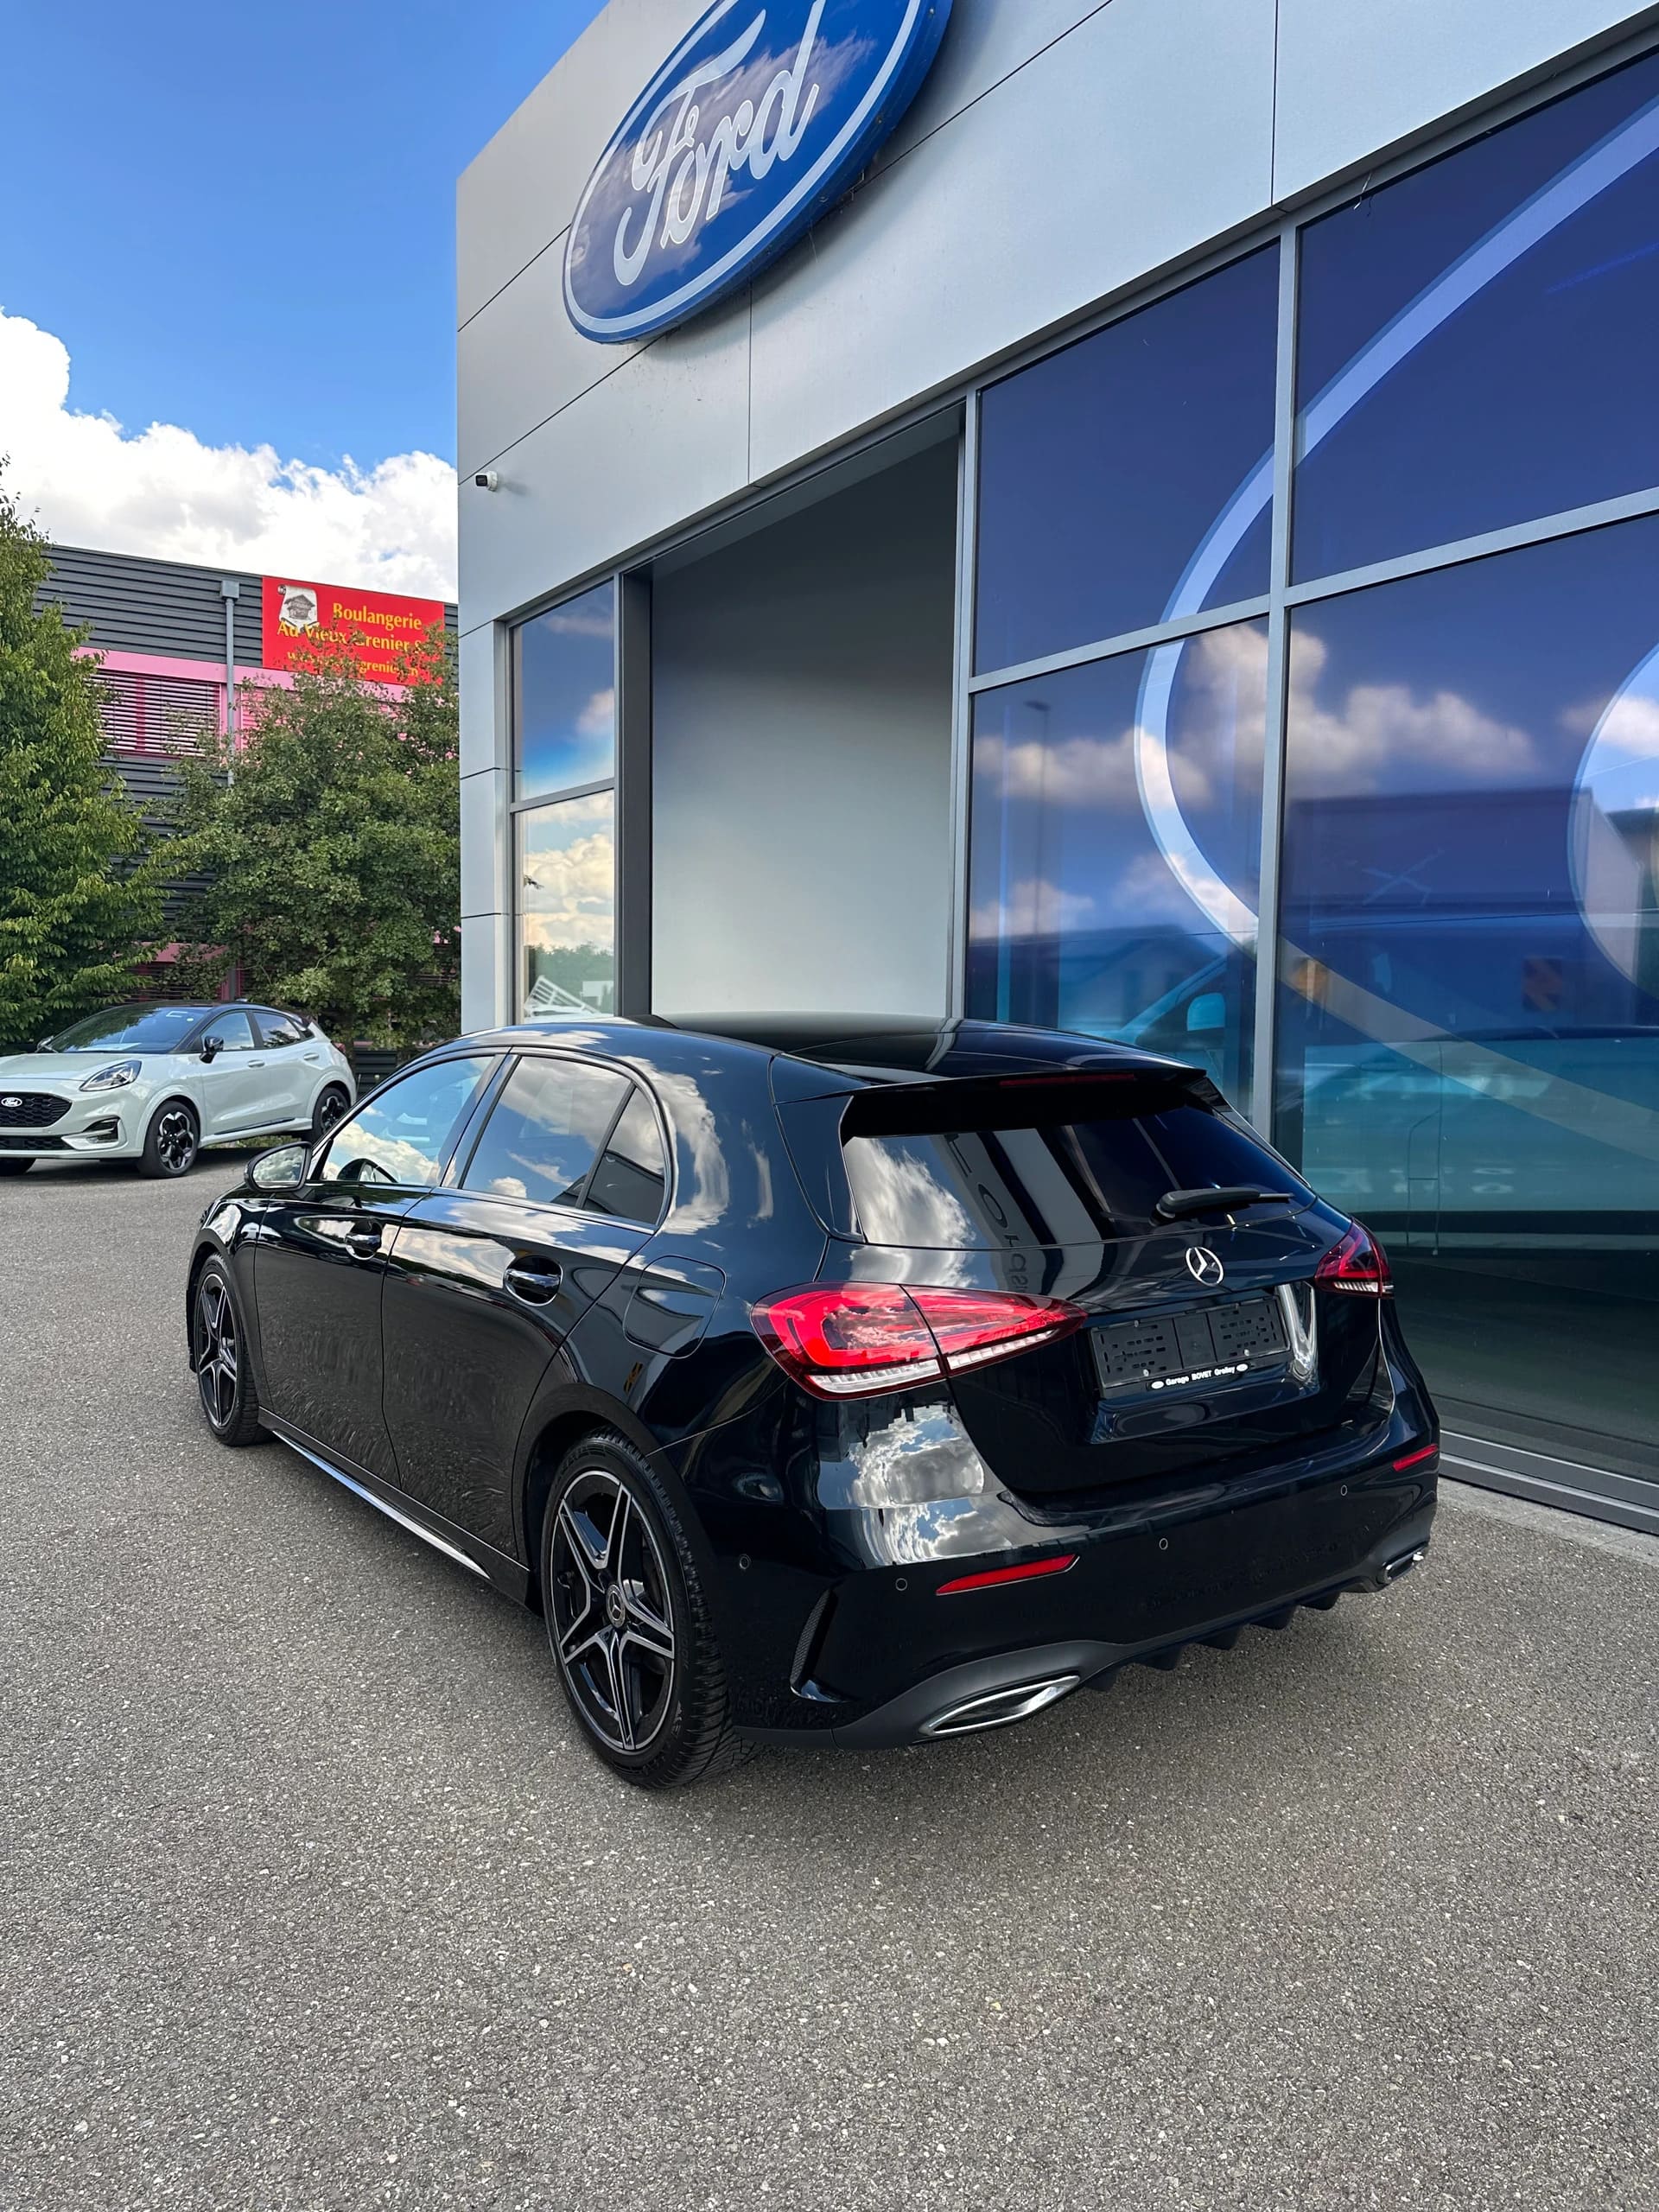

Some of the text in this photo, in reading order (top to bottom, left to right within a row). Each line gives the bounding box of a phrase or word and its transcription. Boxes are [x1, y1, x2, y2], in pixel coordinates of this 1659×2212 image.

[613, 0, 827, 286] Ford
[334, 602, 422, 631] Boulangerie
[276, 620, 299, 637] Au
[1166, 1376, 1189, 1385] Garage
